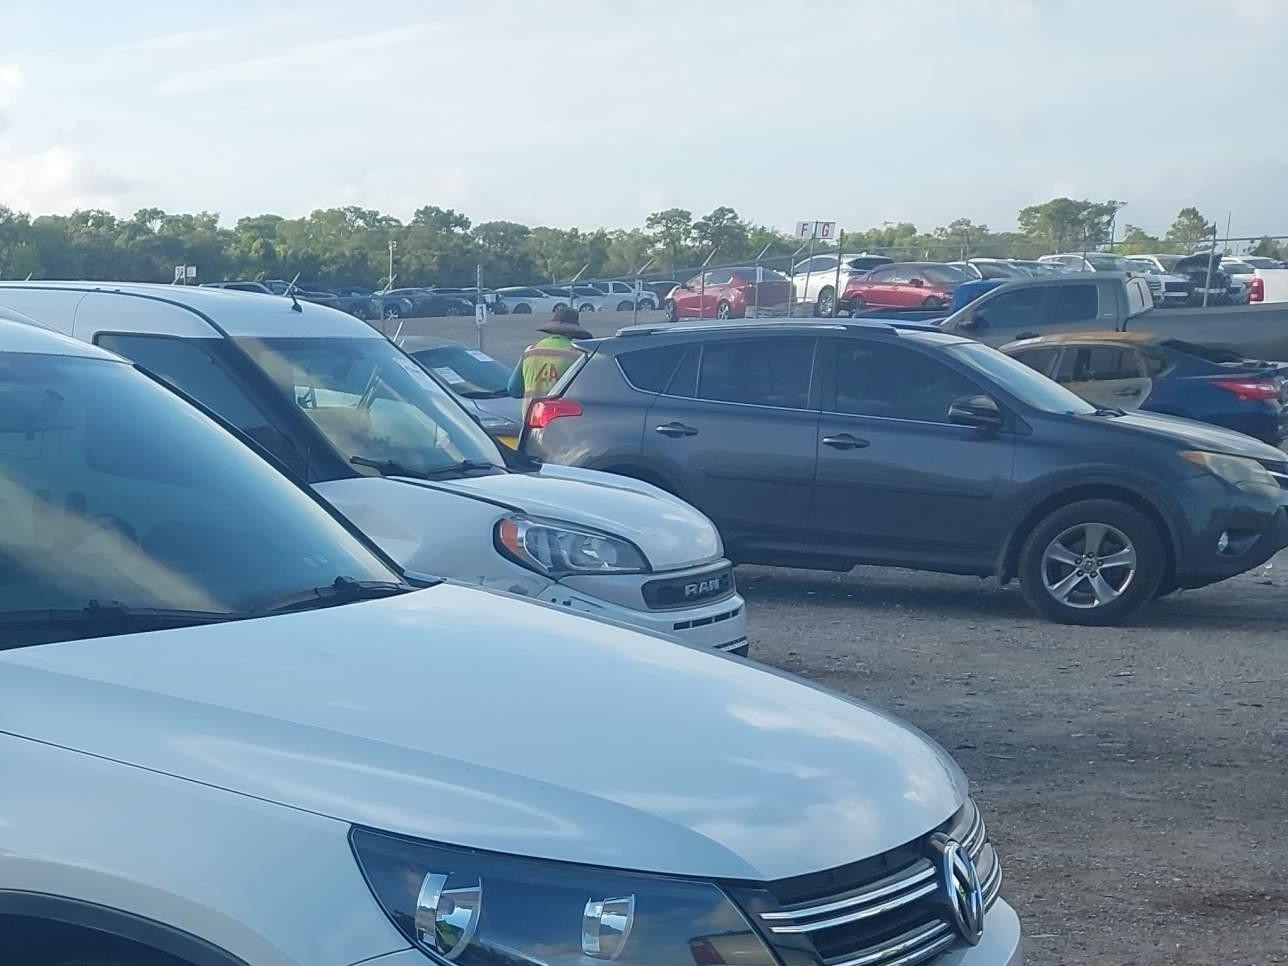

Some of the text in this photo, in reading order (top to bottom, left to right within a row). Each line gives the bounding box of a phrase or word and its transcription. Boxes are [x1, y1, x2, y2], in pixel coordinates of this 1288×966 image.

[800, 223, 809, 237] F
[821, 223, 831, 238] G
[684, 578, 720, 596] RAM
